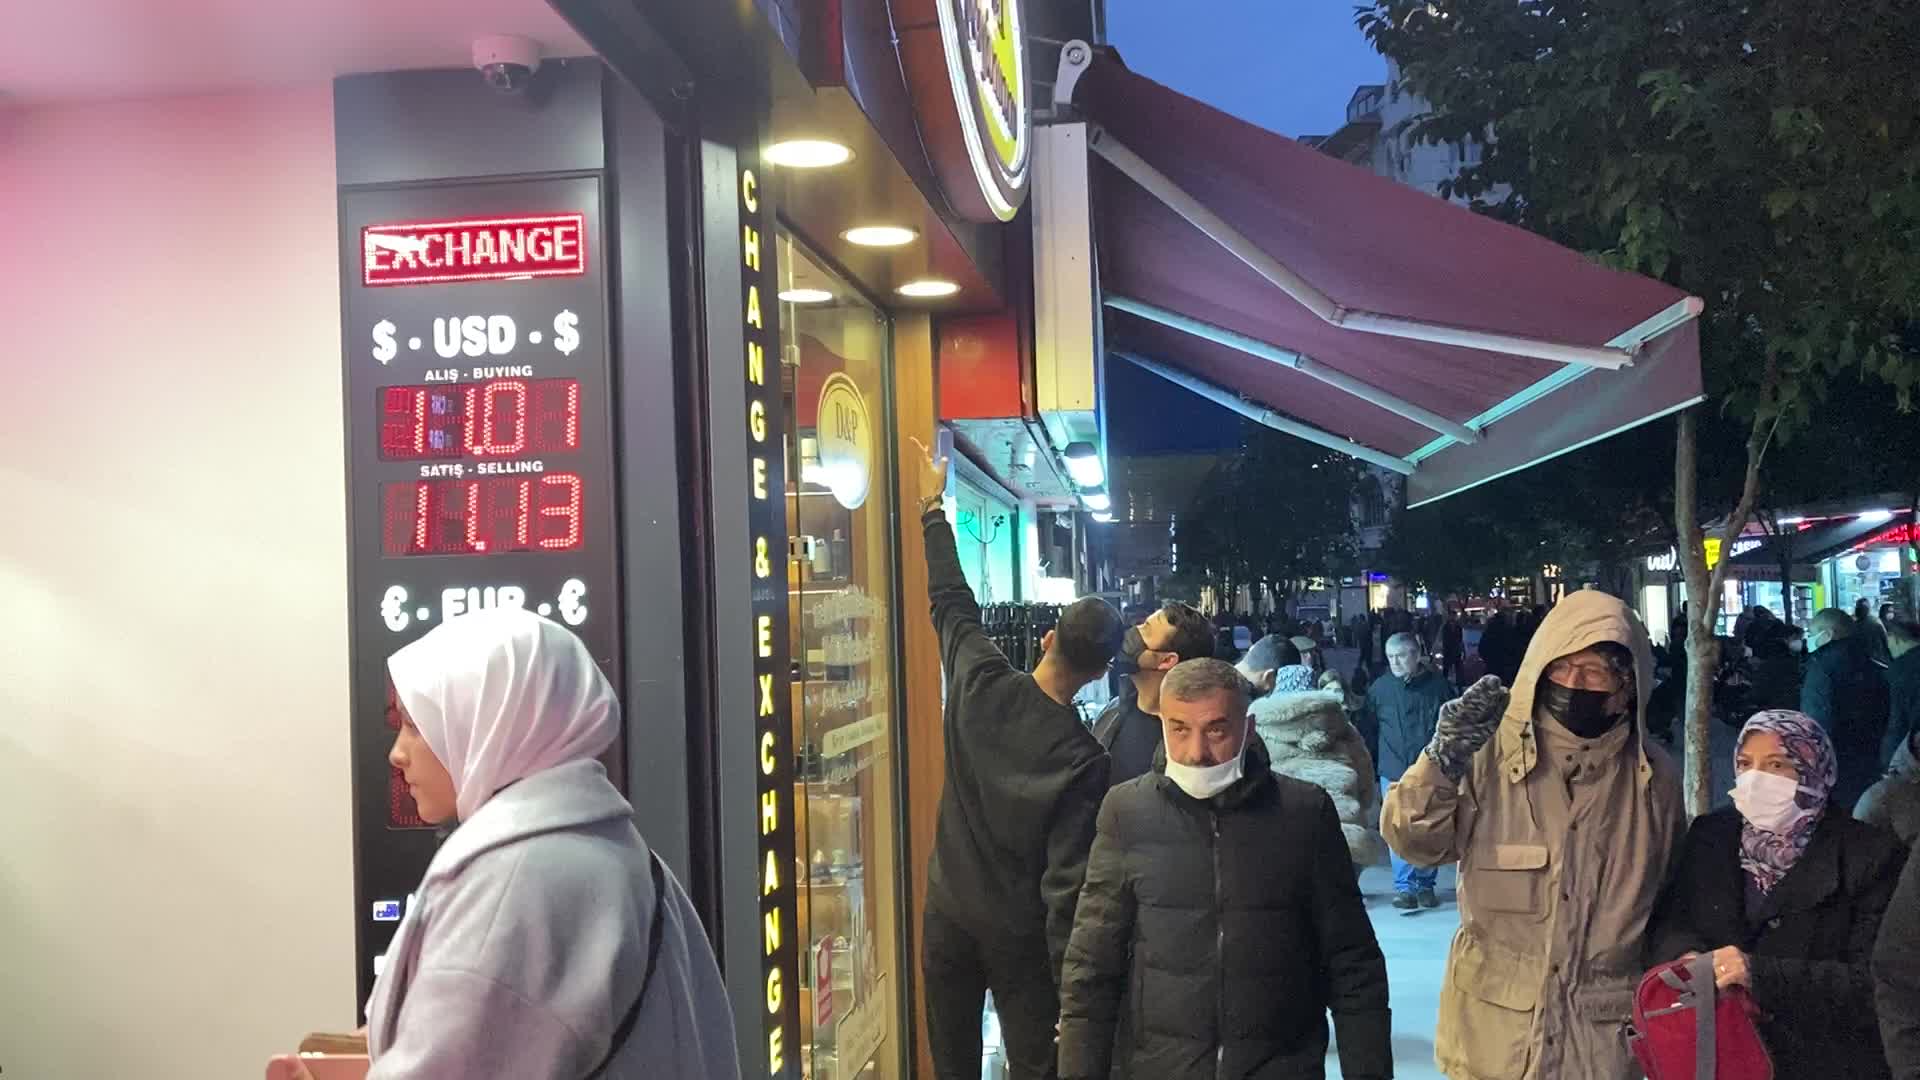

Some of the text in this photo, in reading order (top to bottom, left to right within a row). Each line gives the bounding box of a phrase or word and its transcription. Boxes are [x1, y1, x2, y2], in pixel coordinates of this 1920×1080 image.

[366, 226, 578, 271] EXCHANGE
[372, 319, 398, 366] $
[432, 314, 517, 359] USD
[553, 308, 581, 357] $
[742, 169, 768, 500] CHANGE
[424, 368, 460, 384] ALIŞ
[472, 365, 534, 381] BUYING
[420, 463, 465, 479] SATIŞ
[477, 460, 544, 475] SELLING
[414, 474, 582, 552] 11.13
[754, 535, 770, 579] &
[380, 584, 409, 633] €
[557, 577, 588, 626] €
[757, 614, 784, 1077] EXCHANGE
